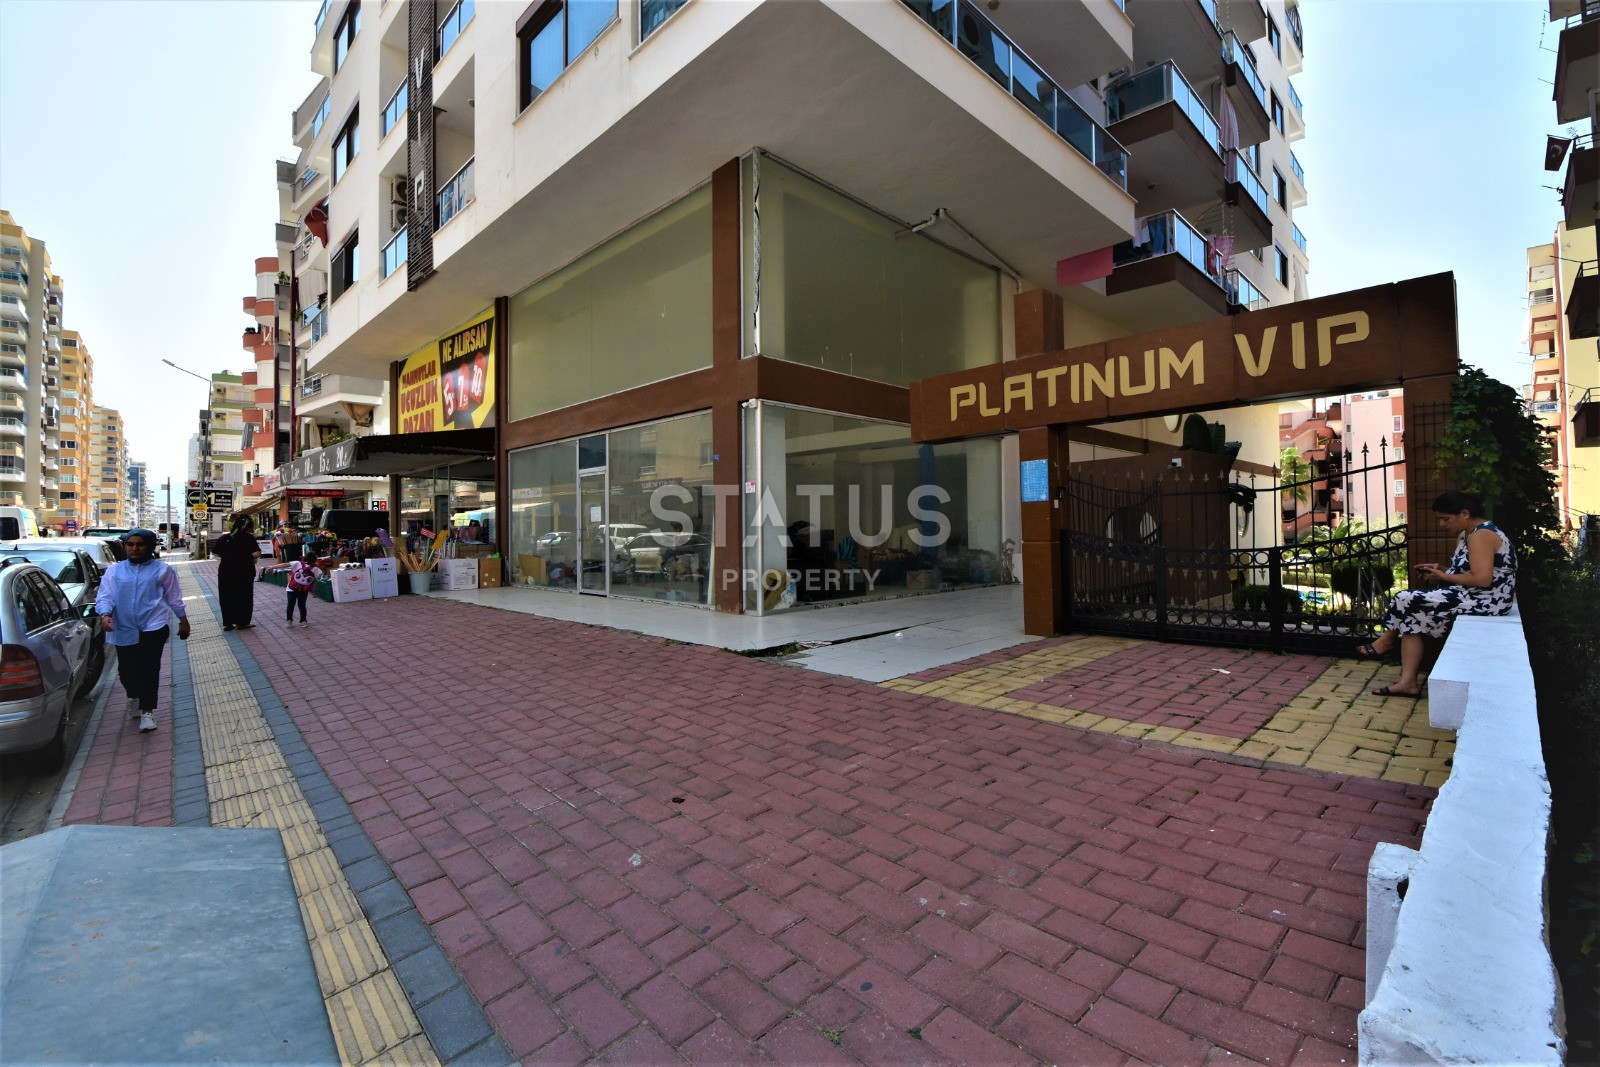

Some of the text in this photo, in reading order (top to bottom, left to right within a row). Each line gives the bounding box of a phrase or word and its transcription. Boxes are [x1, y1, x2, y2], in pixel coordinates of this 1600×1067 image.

[443, 323, 487, 363] NE ALIRSAN
[951, 310, 1370, 421] PLATINUM VIP
[401, 378, 438, 414] UCUZLUK
